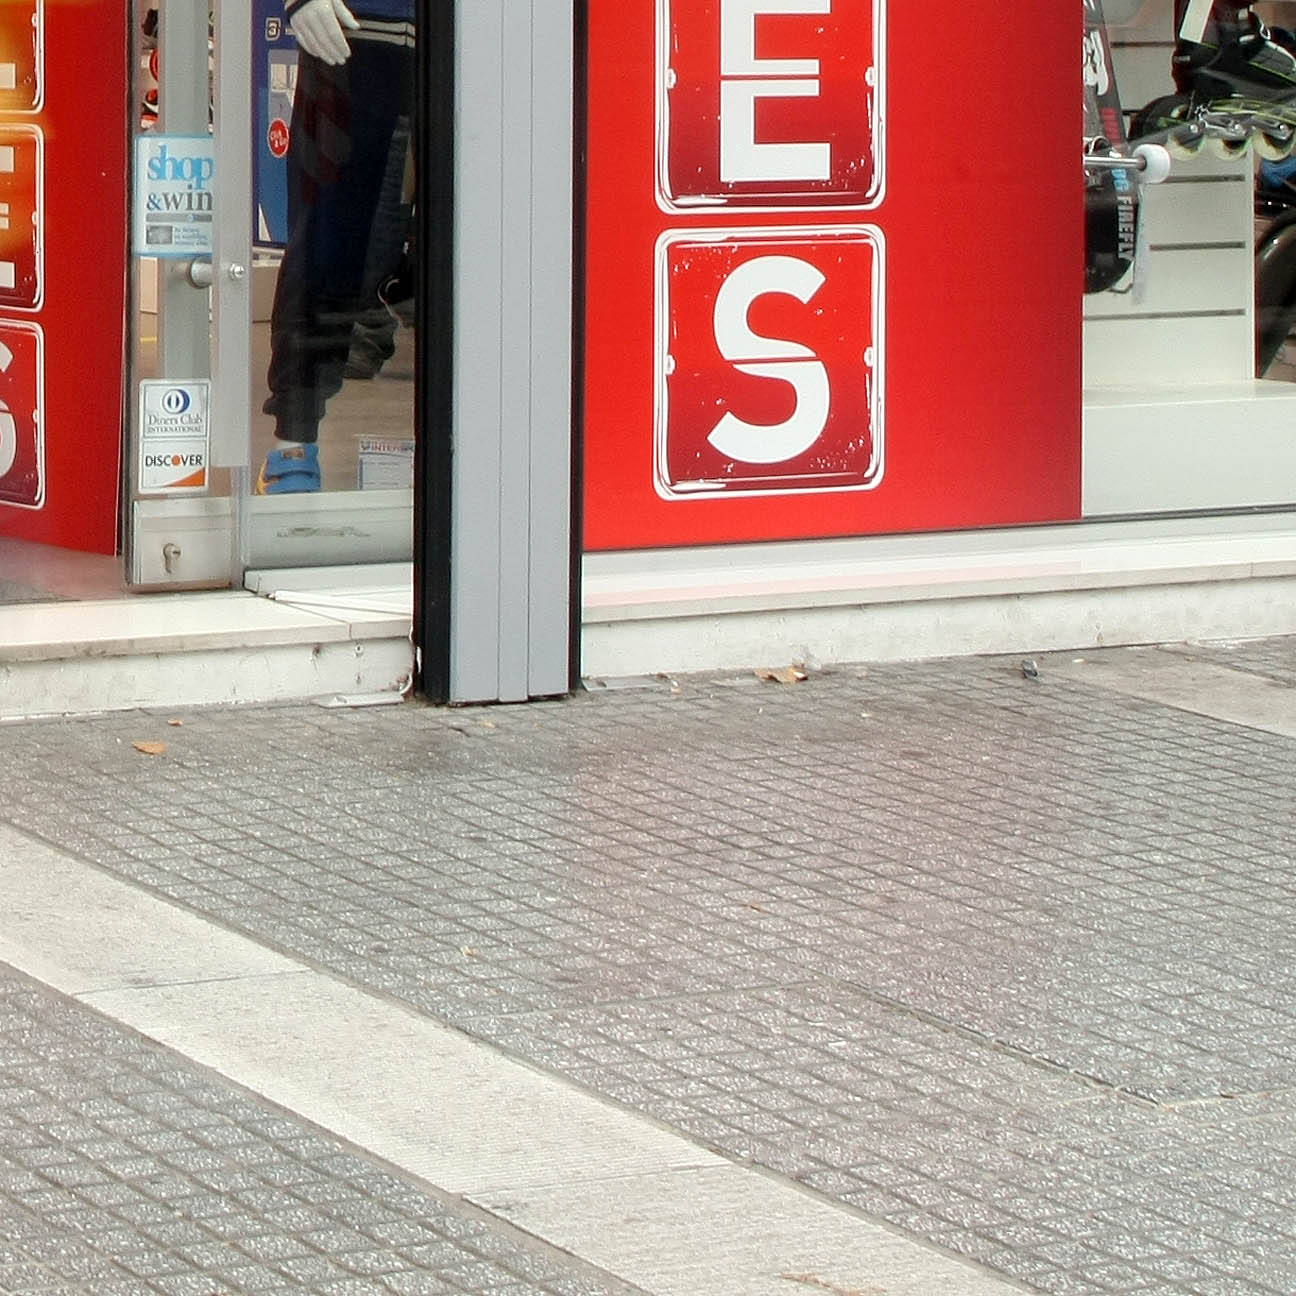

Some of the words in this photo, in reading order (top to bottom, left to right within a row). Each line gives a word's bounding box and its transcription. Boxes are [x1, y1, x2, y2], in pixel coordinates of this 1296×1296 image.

[146, 143, 214, 190] shop
[149, 414, 178, 425] Diners
[180, 413, 203, 425] Club
[145, 455, 203, 467] DISCOVER
